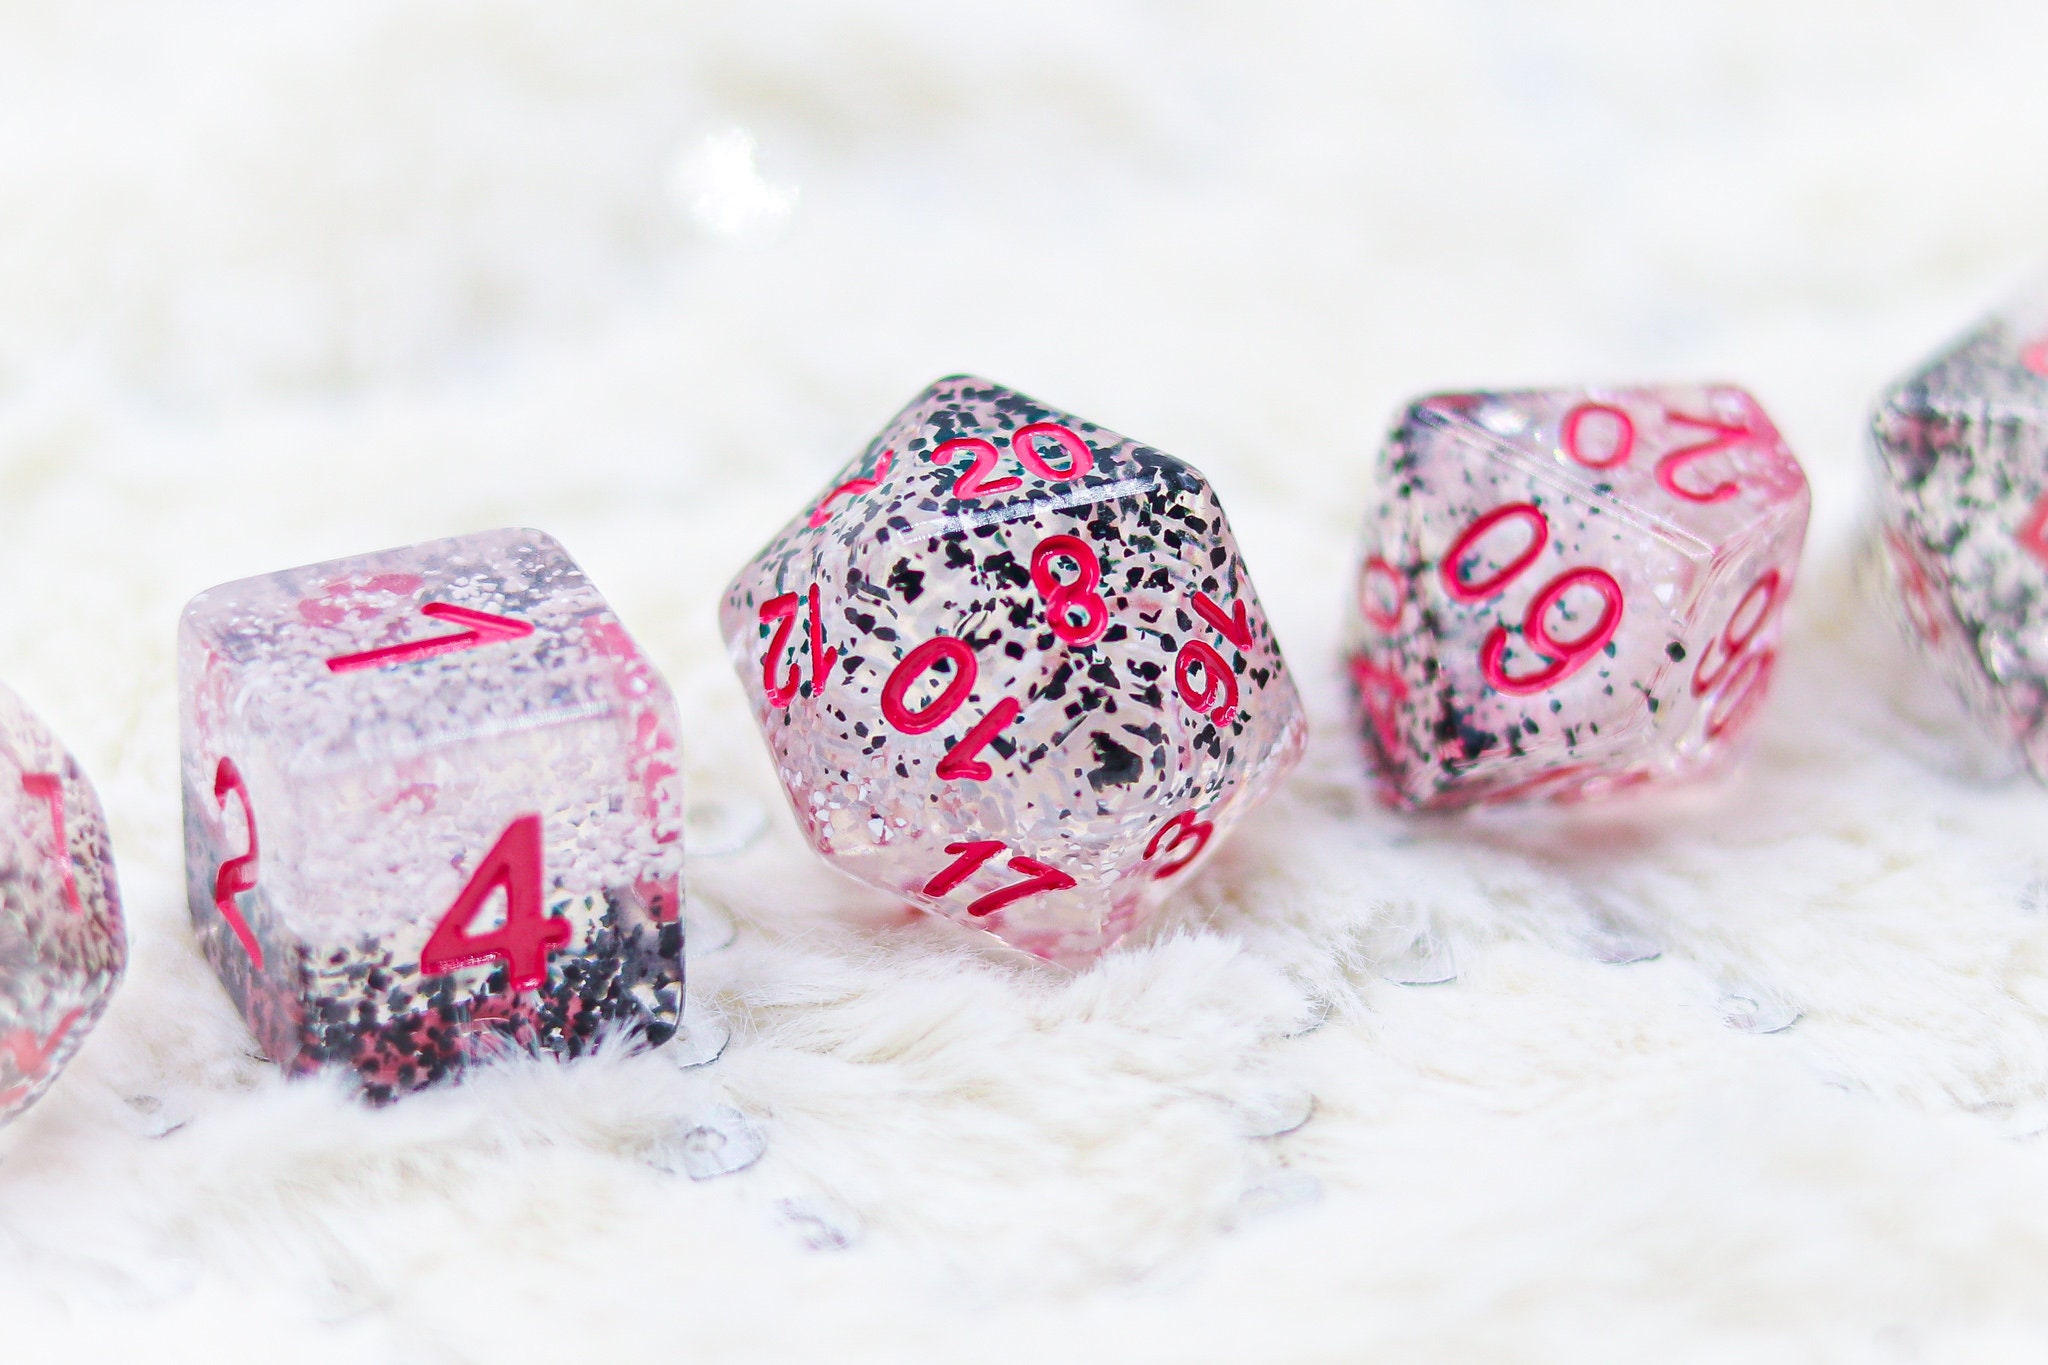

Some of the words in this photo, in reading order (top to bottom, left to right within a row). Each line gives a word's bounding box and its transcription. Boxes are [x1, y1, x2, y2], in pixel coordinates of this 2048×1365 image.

[929, 420, 1095, 502] 20
[1560, 402, 1781, 505] 20
[324, 600, 536, 675] 1
[757, 582, 839, 710] 12
[1028, 533, 1112, 649] 8
[879, 634, 1022, 784] 10
[1173, 590, 1257, 730] 16
[212, 755, 265, 972] 2
[921, 838, 1079, 919] 17
[1142, 808, 1215, 881] 3
[419, 812, 574, 995] 4
